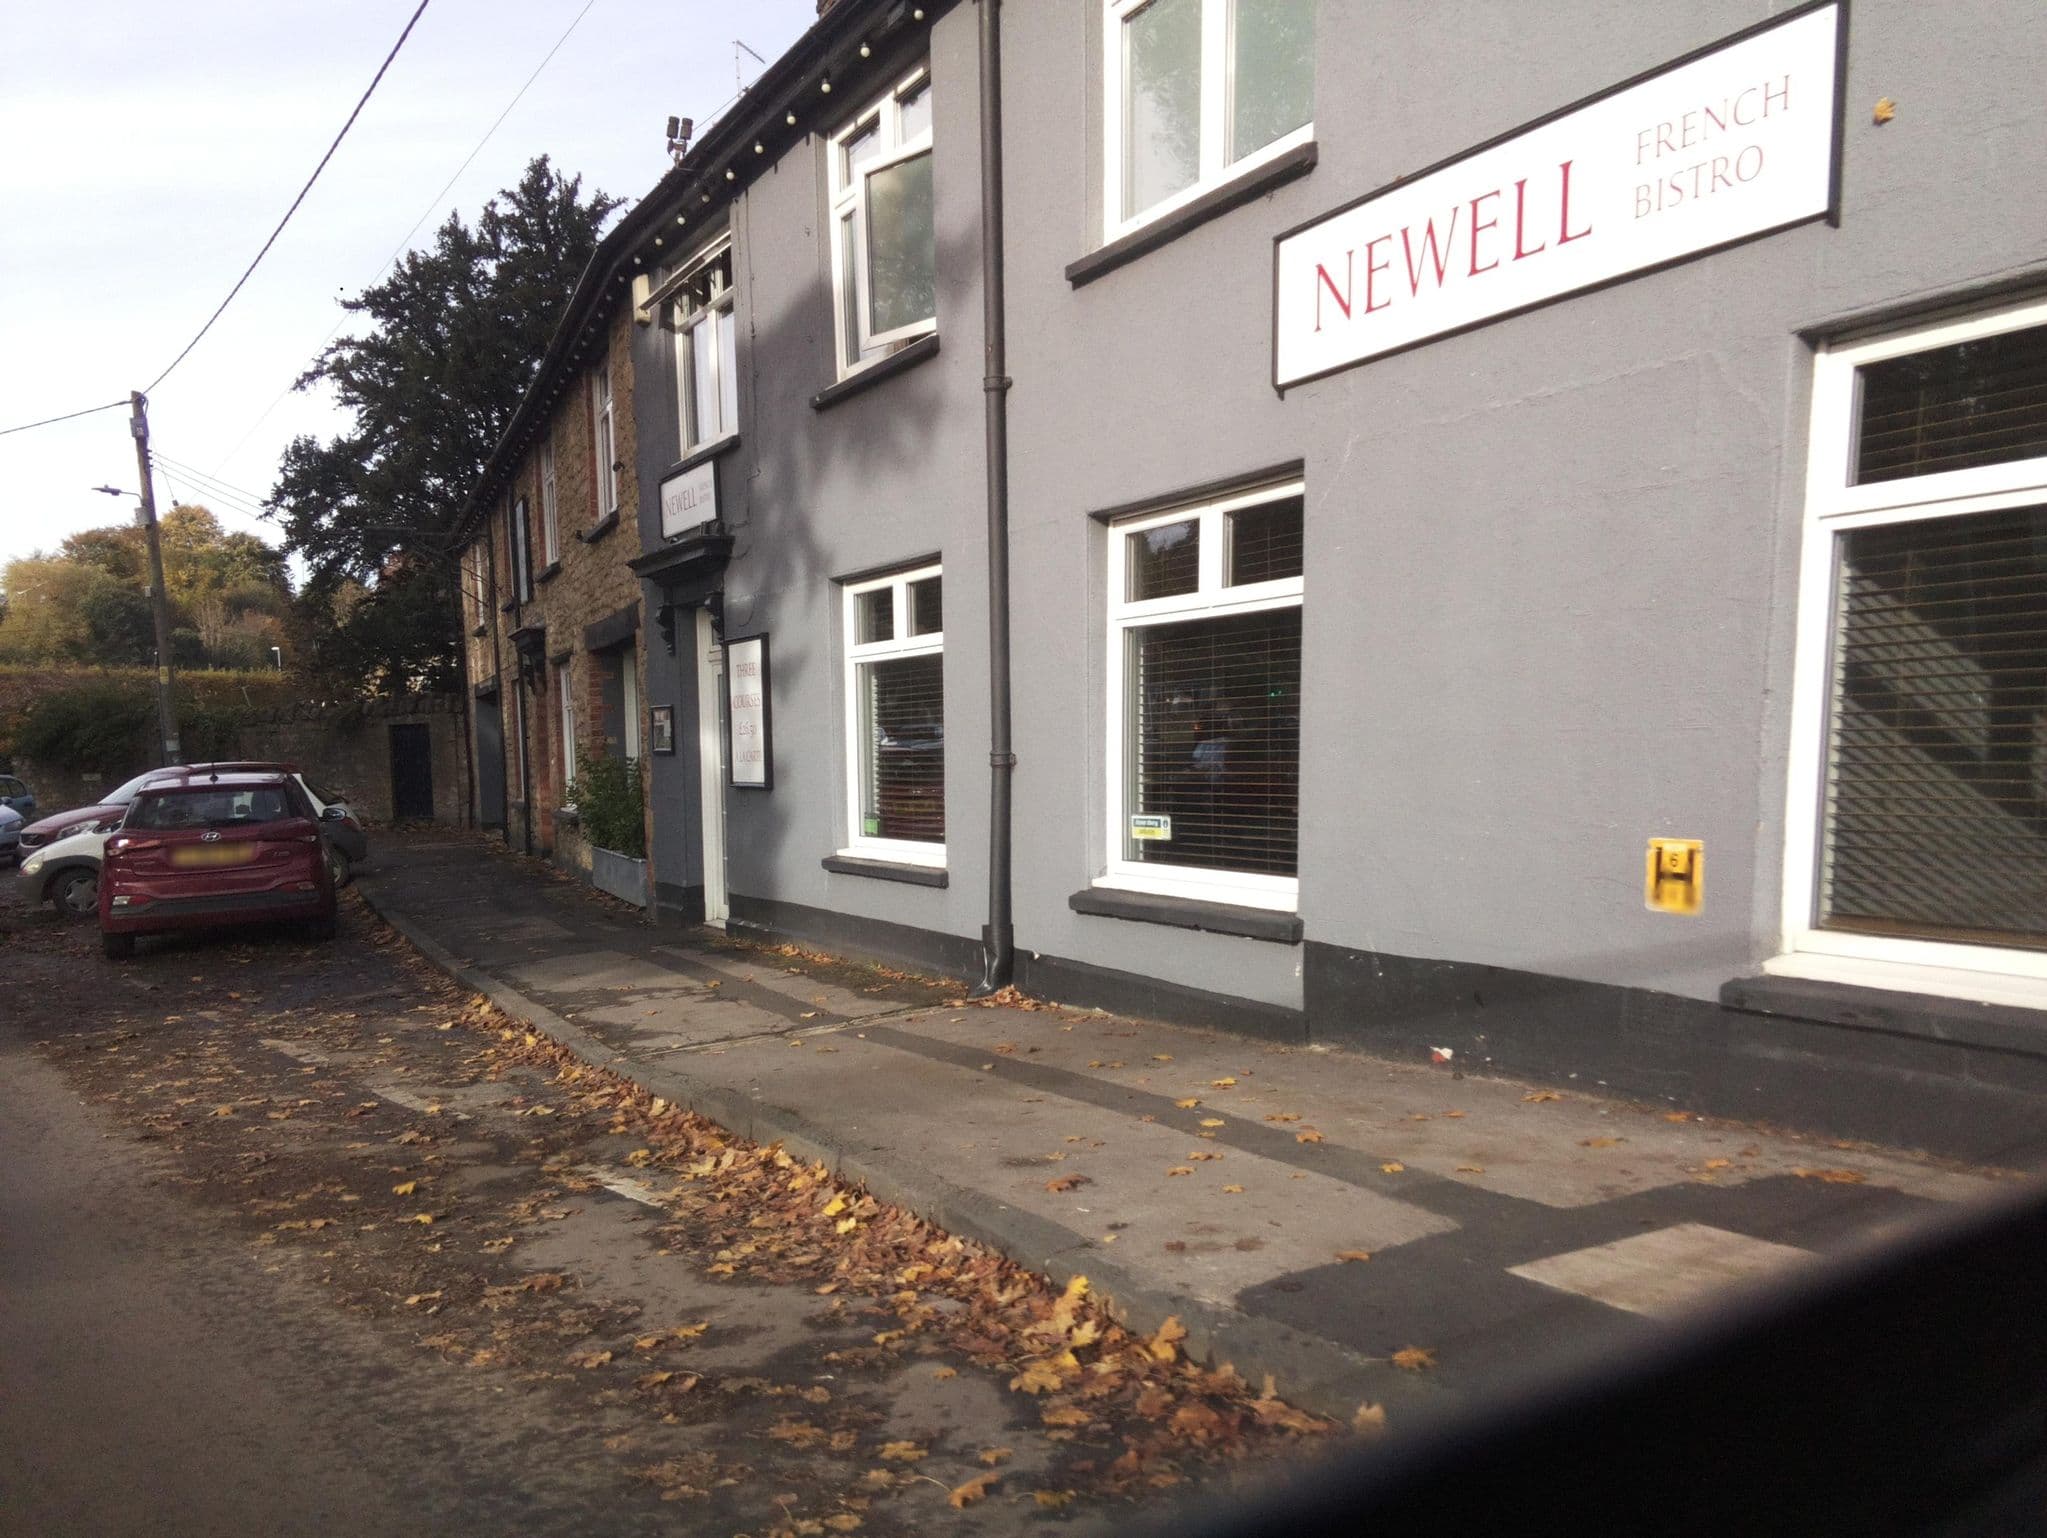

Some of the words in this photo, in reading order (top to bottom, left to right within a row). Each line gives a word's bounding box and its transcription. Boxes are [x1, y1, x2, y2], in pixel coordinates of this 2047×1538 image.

[1636, 74, 1791, 165] FRENCH
[1634, 144, 1764, 219] BISTRO
[1314, 159, 1593, 332] NEWELL
[664, 487, 697, 520] NEWELL
